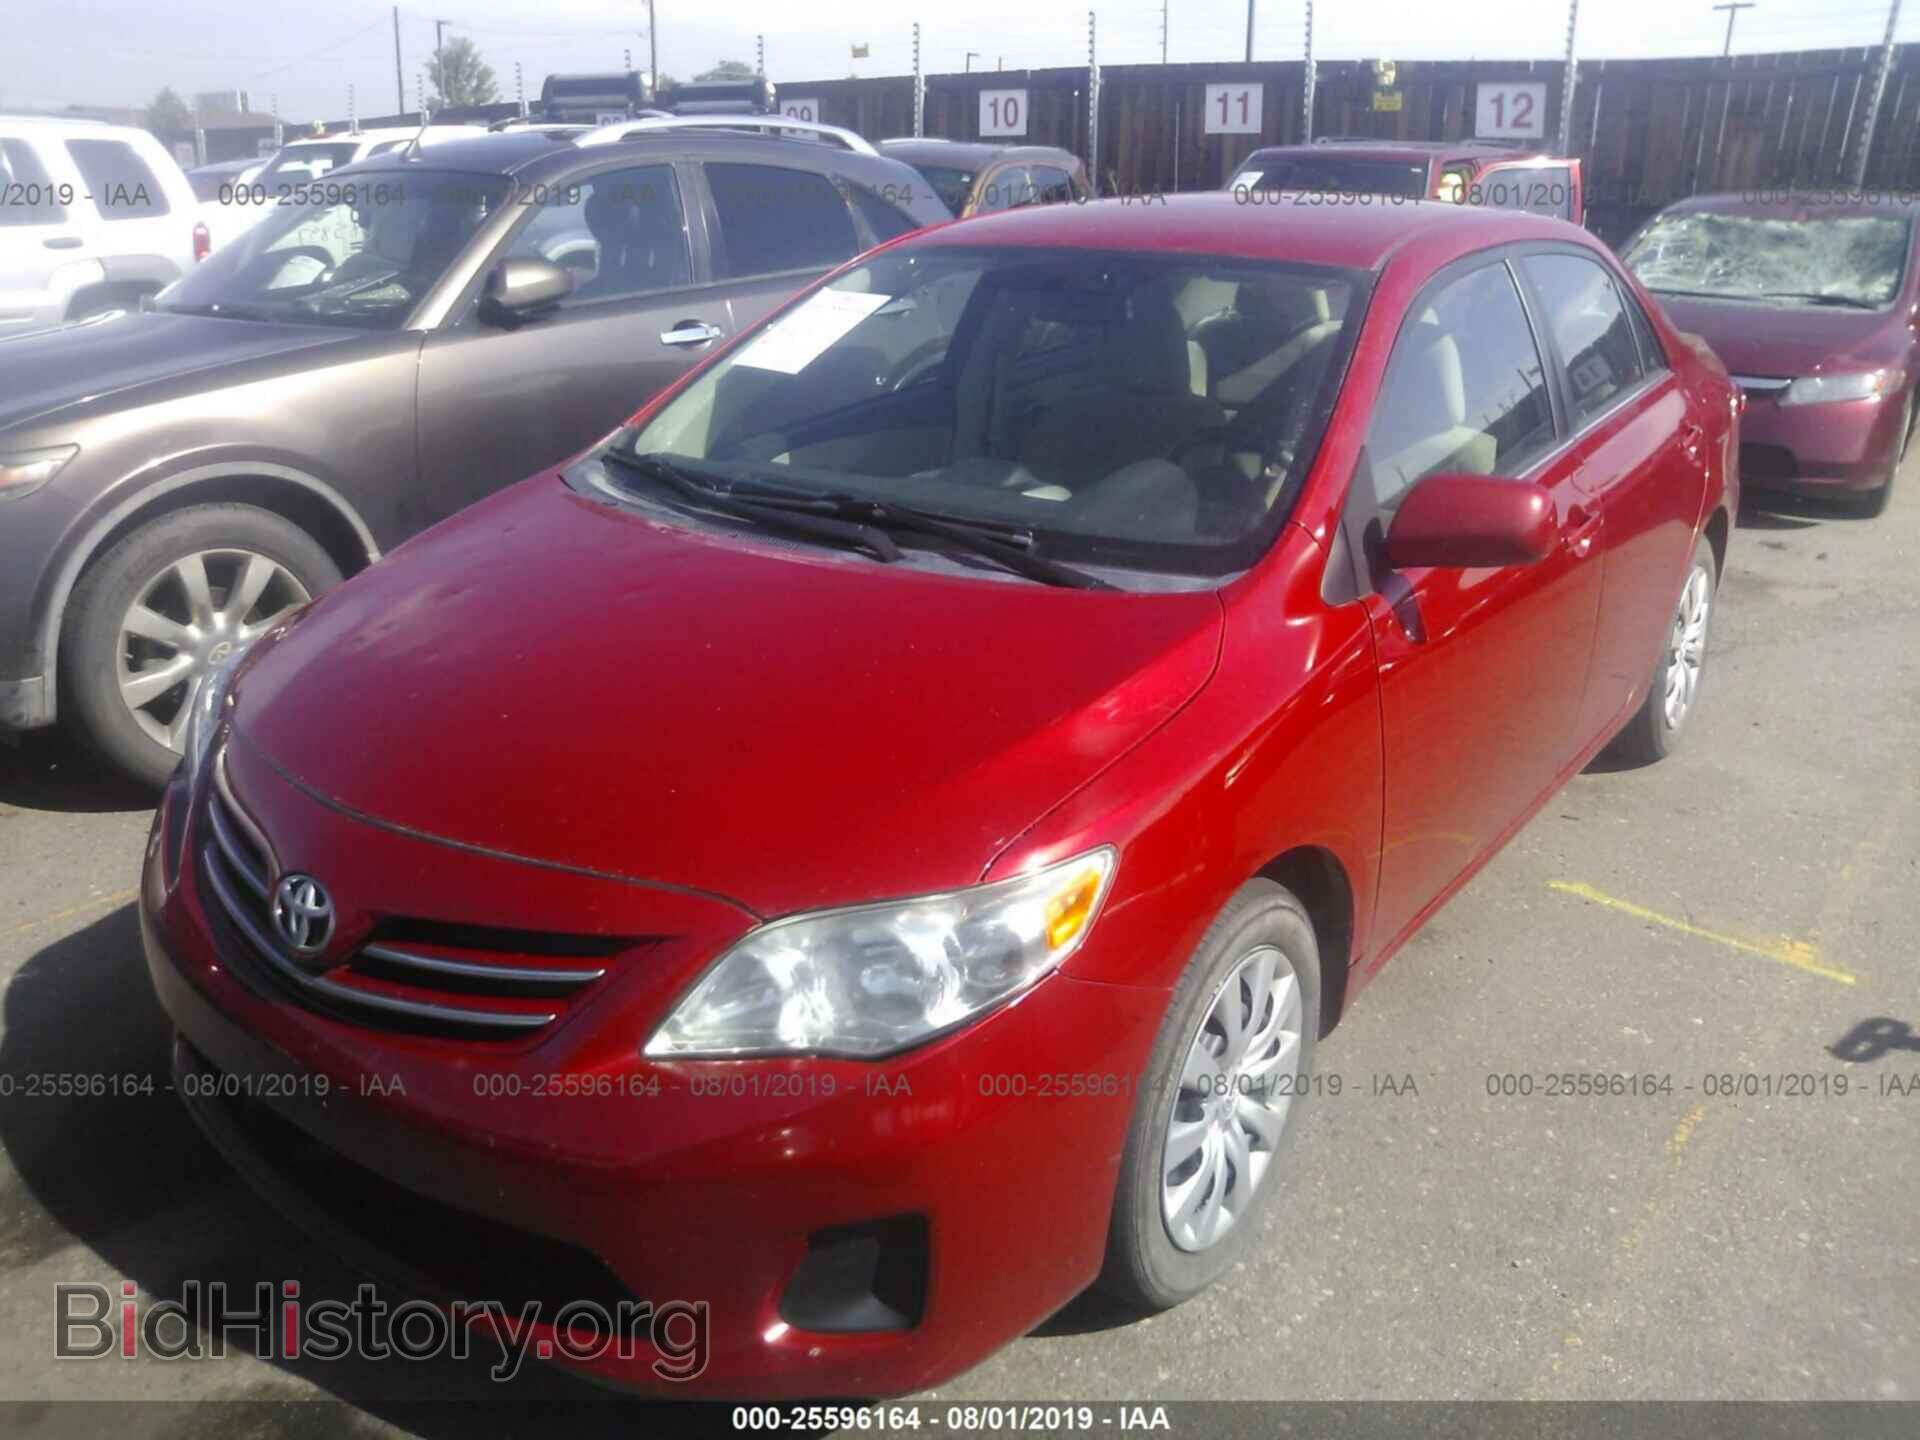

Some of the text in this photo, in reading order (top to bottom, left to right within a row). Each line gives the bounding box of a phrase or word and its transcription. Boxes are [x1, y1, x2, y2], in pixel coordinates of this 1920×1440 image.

[989, 96, 1019, 128] 10
[1217, 91, 1249, 125] 11
[1489, 91, 1533, 128] 12
